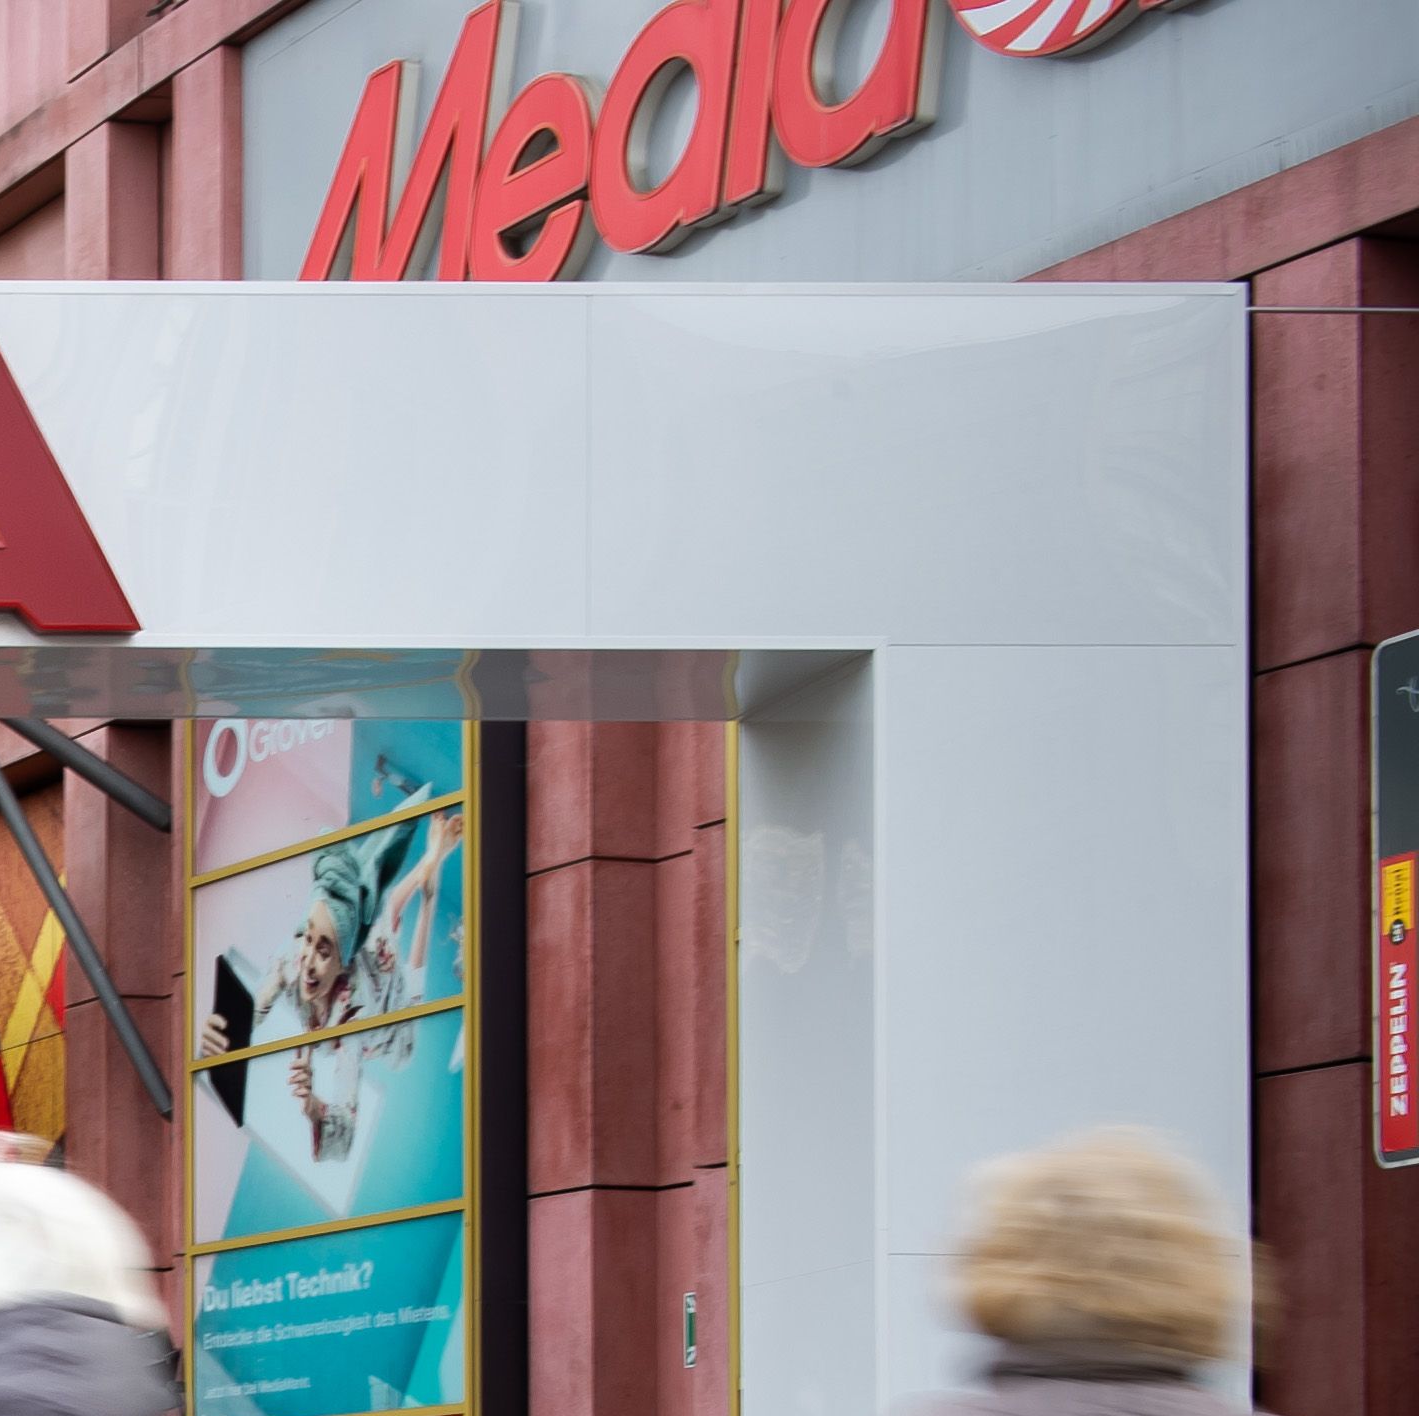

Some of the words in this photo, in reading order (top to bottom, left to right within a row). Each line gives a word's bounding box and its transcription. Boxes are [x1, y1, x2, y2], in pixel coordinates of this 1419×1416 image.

[298, 0, 925, 281] Media
[1388, 963, 1409, 1117] ZEPPELIN
[203, 1285, 229, 1312] Du
[231, 1277, 283, 1309] liebst
[285, 1260, 374, 1300] Technik?
[373, 1310, 395, 1328] des
